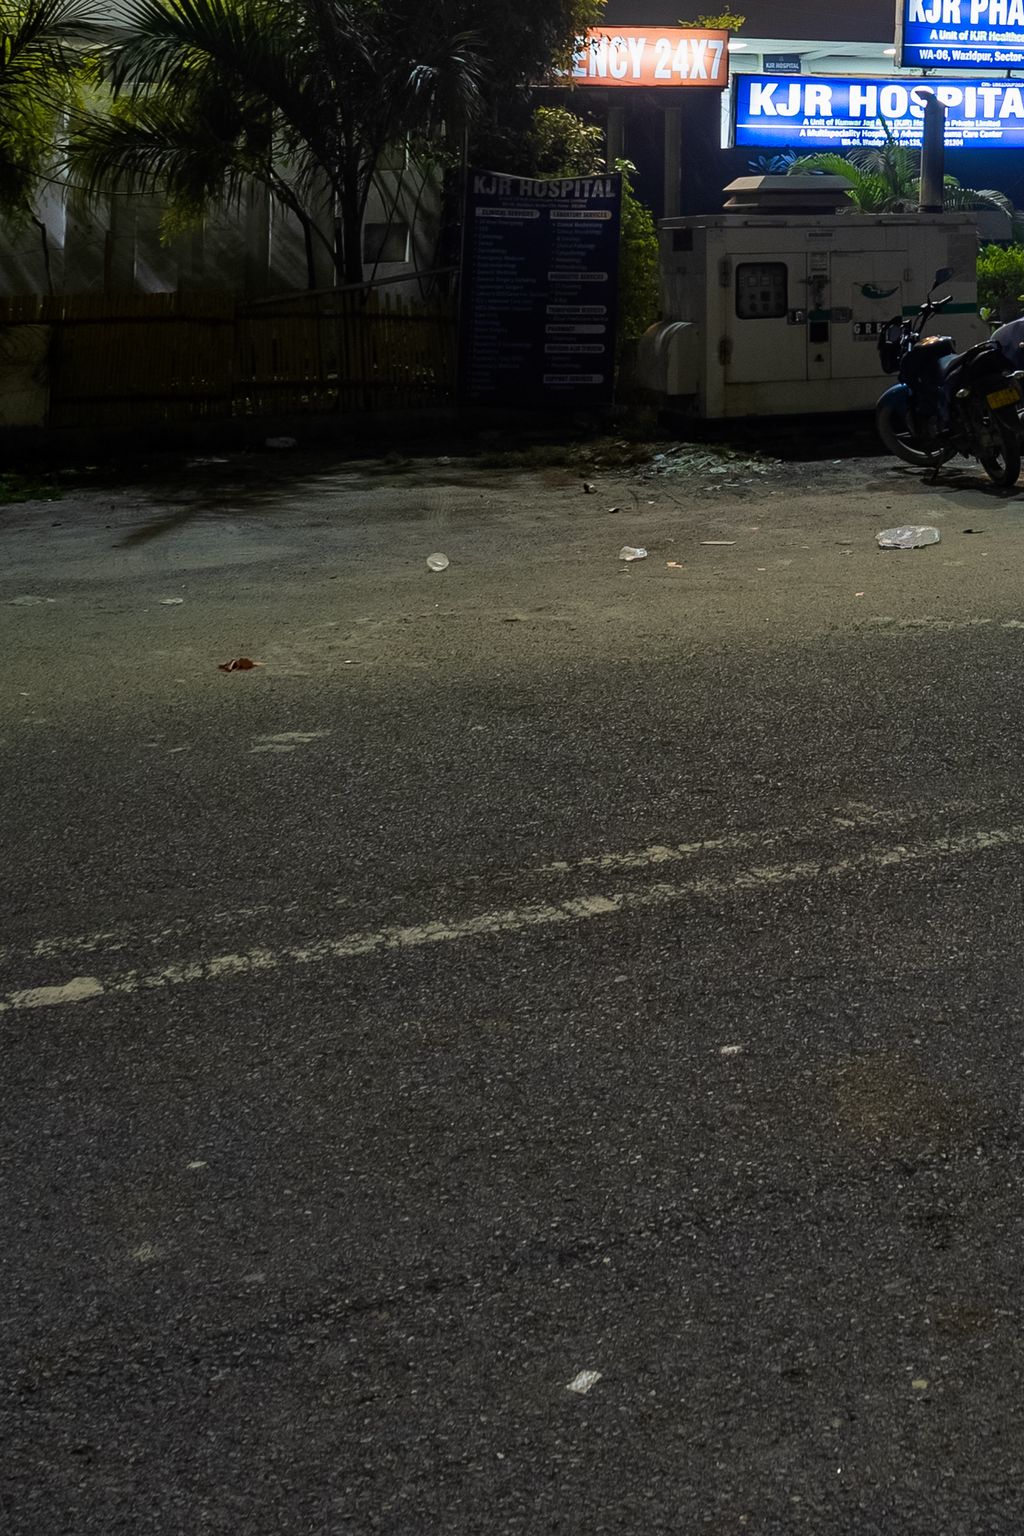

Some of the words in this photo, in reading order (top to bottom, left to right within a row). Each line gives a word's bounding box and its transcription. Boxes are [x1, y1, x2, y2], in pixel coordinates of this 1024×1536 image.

[930, 29, 938, 40] A
[939, 30, 957, 40] Unit
[959, 30, 969, 40] of
[970, 31, 987, 41] KJR
[553, 35, 647, 78] ENCY
[654, 37, 724, 80] 24X7
[919, 49, 950, 61] WA-06,
[749, 82, 833, 117] KJR
[799, 129, 806, 137] A
[473, 175, 512, 195] KJR
[519, 179, 615, 198] HOSPITAL
